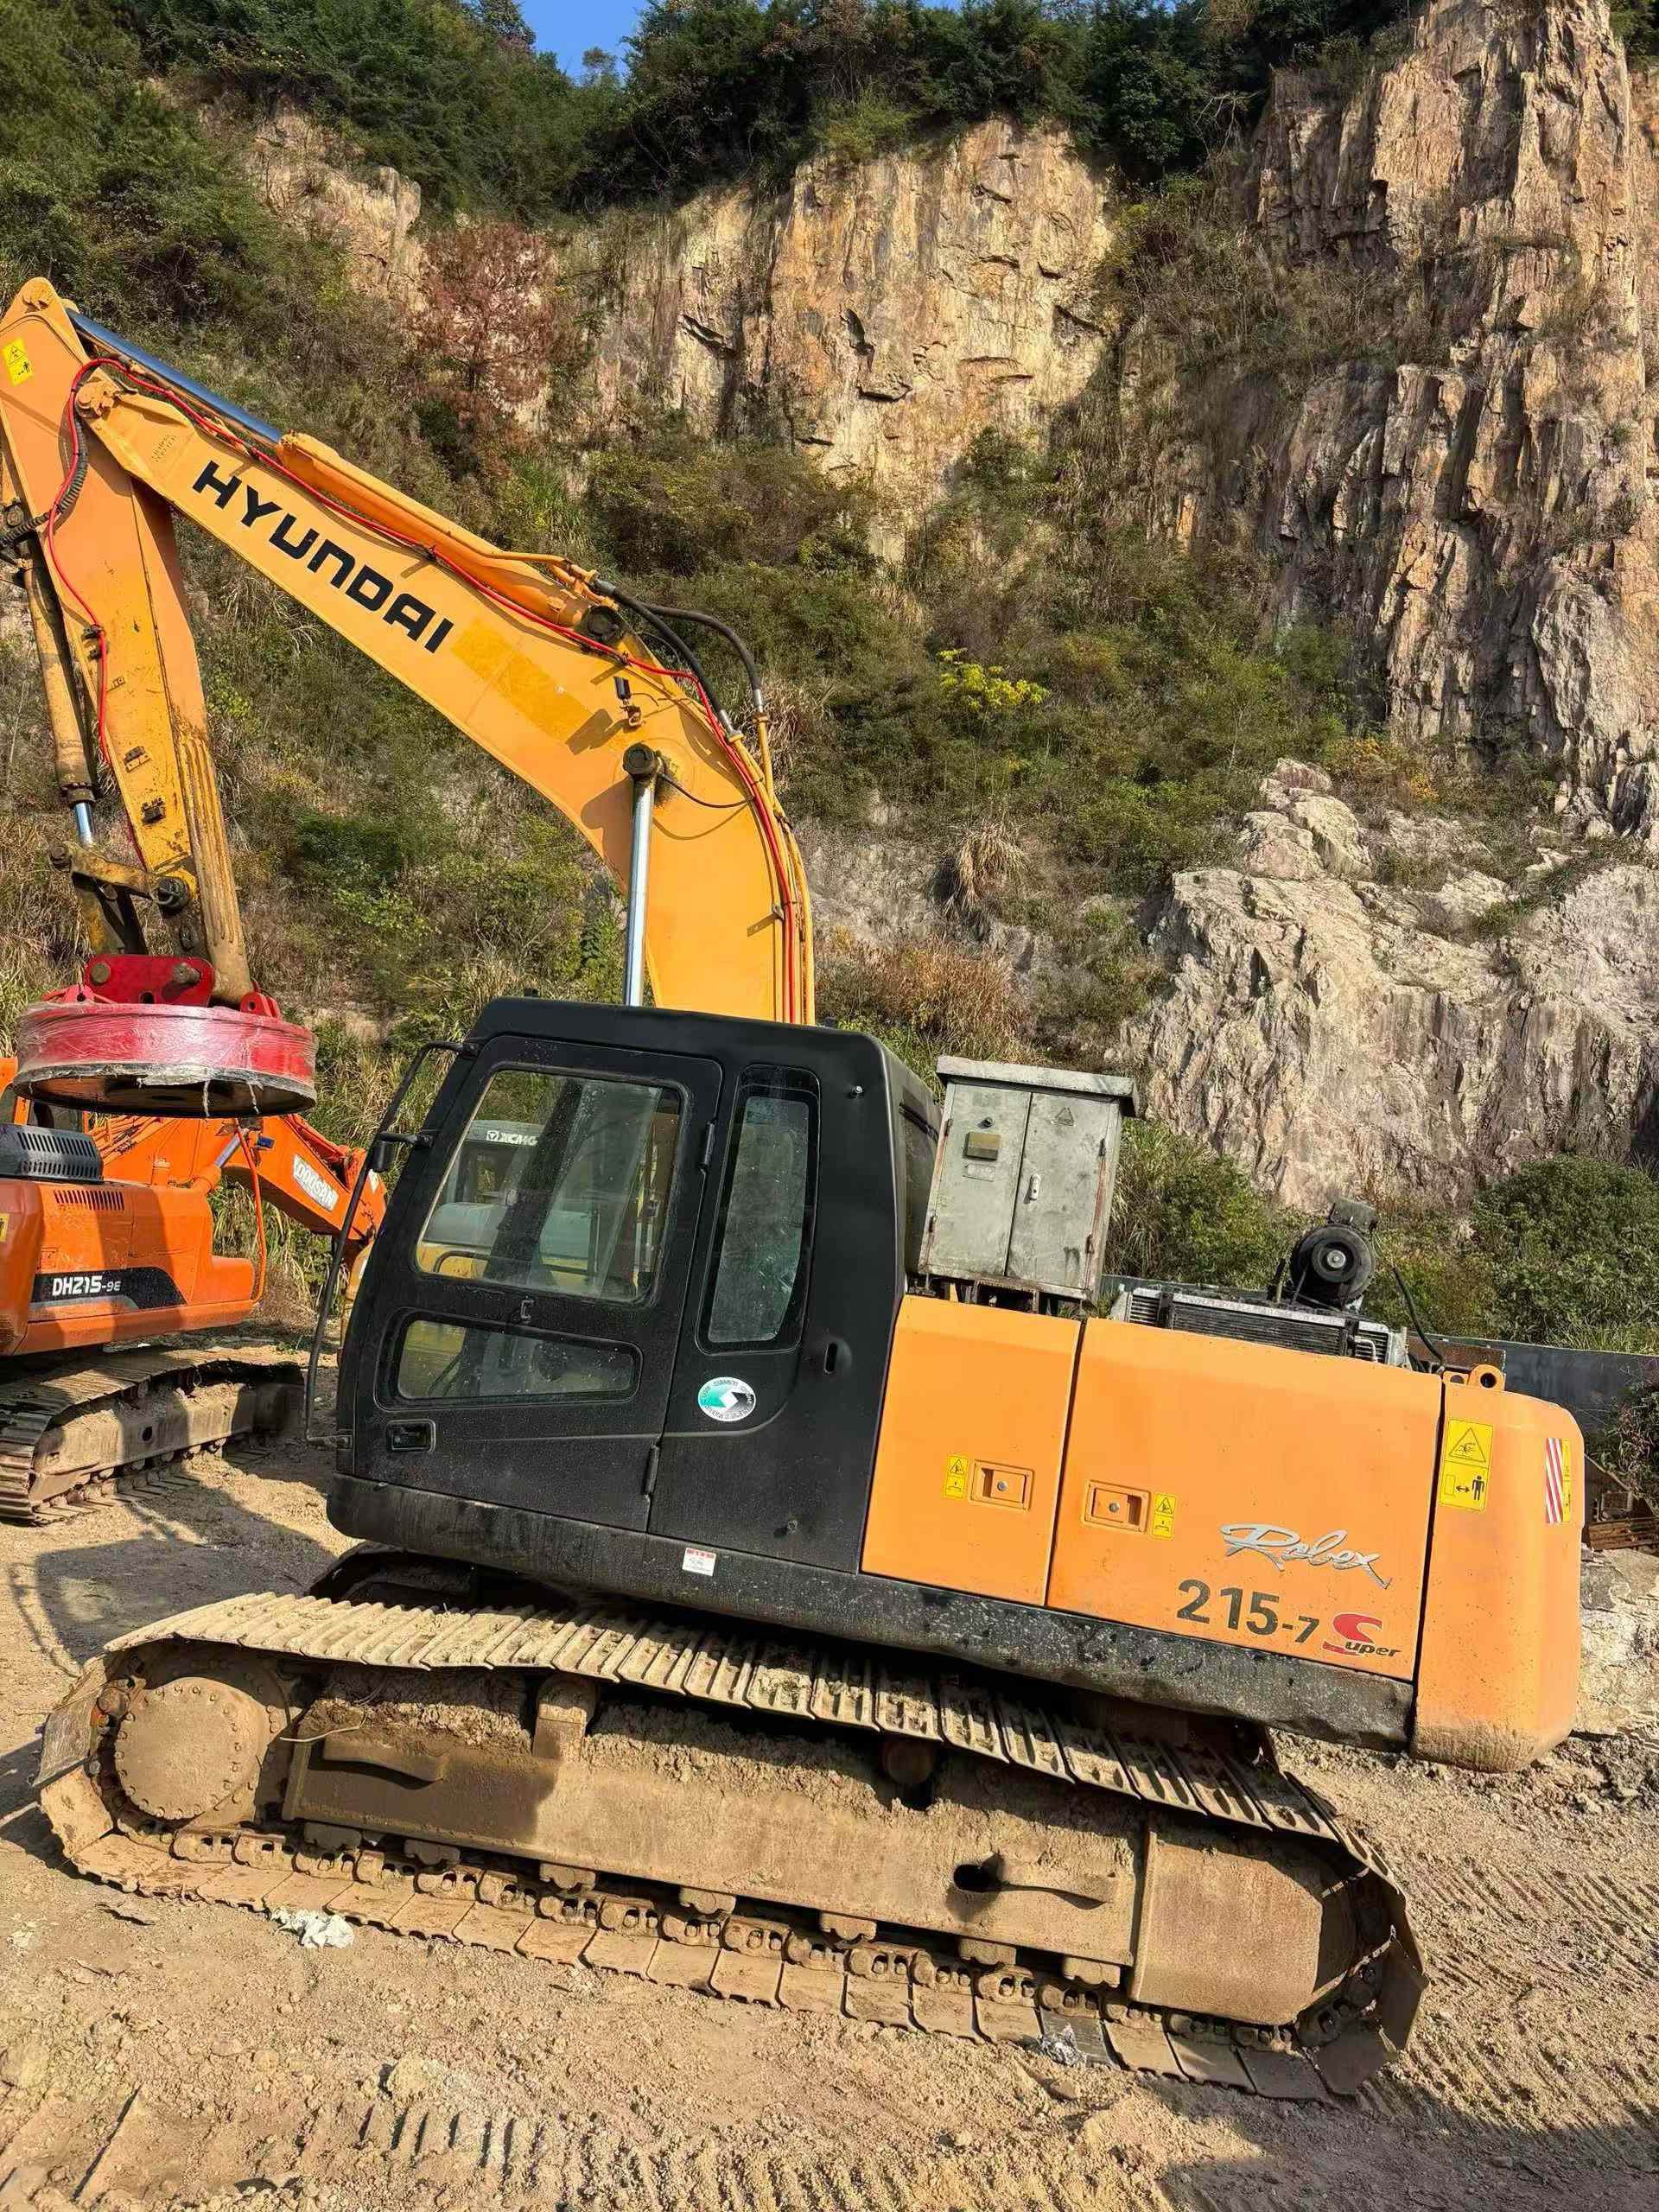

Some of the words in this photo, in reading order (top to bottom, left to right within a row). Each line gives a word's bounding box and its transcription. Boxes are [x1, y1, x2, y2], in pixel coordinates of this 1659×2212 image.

[192, 460, 454, 654] HYUNDAI
[52, 1275, 121, 1296] DH215-9E
[1219, 1523, 1393, 1590] Robex
[1176, 1579, 1320, 1643] 215-7
[1320, 1612, 1402, 1657] Super
